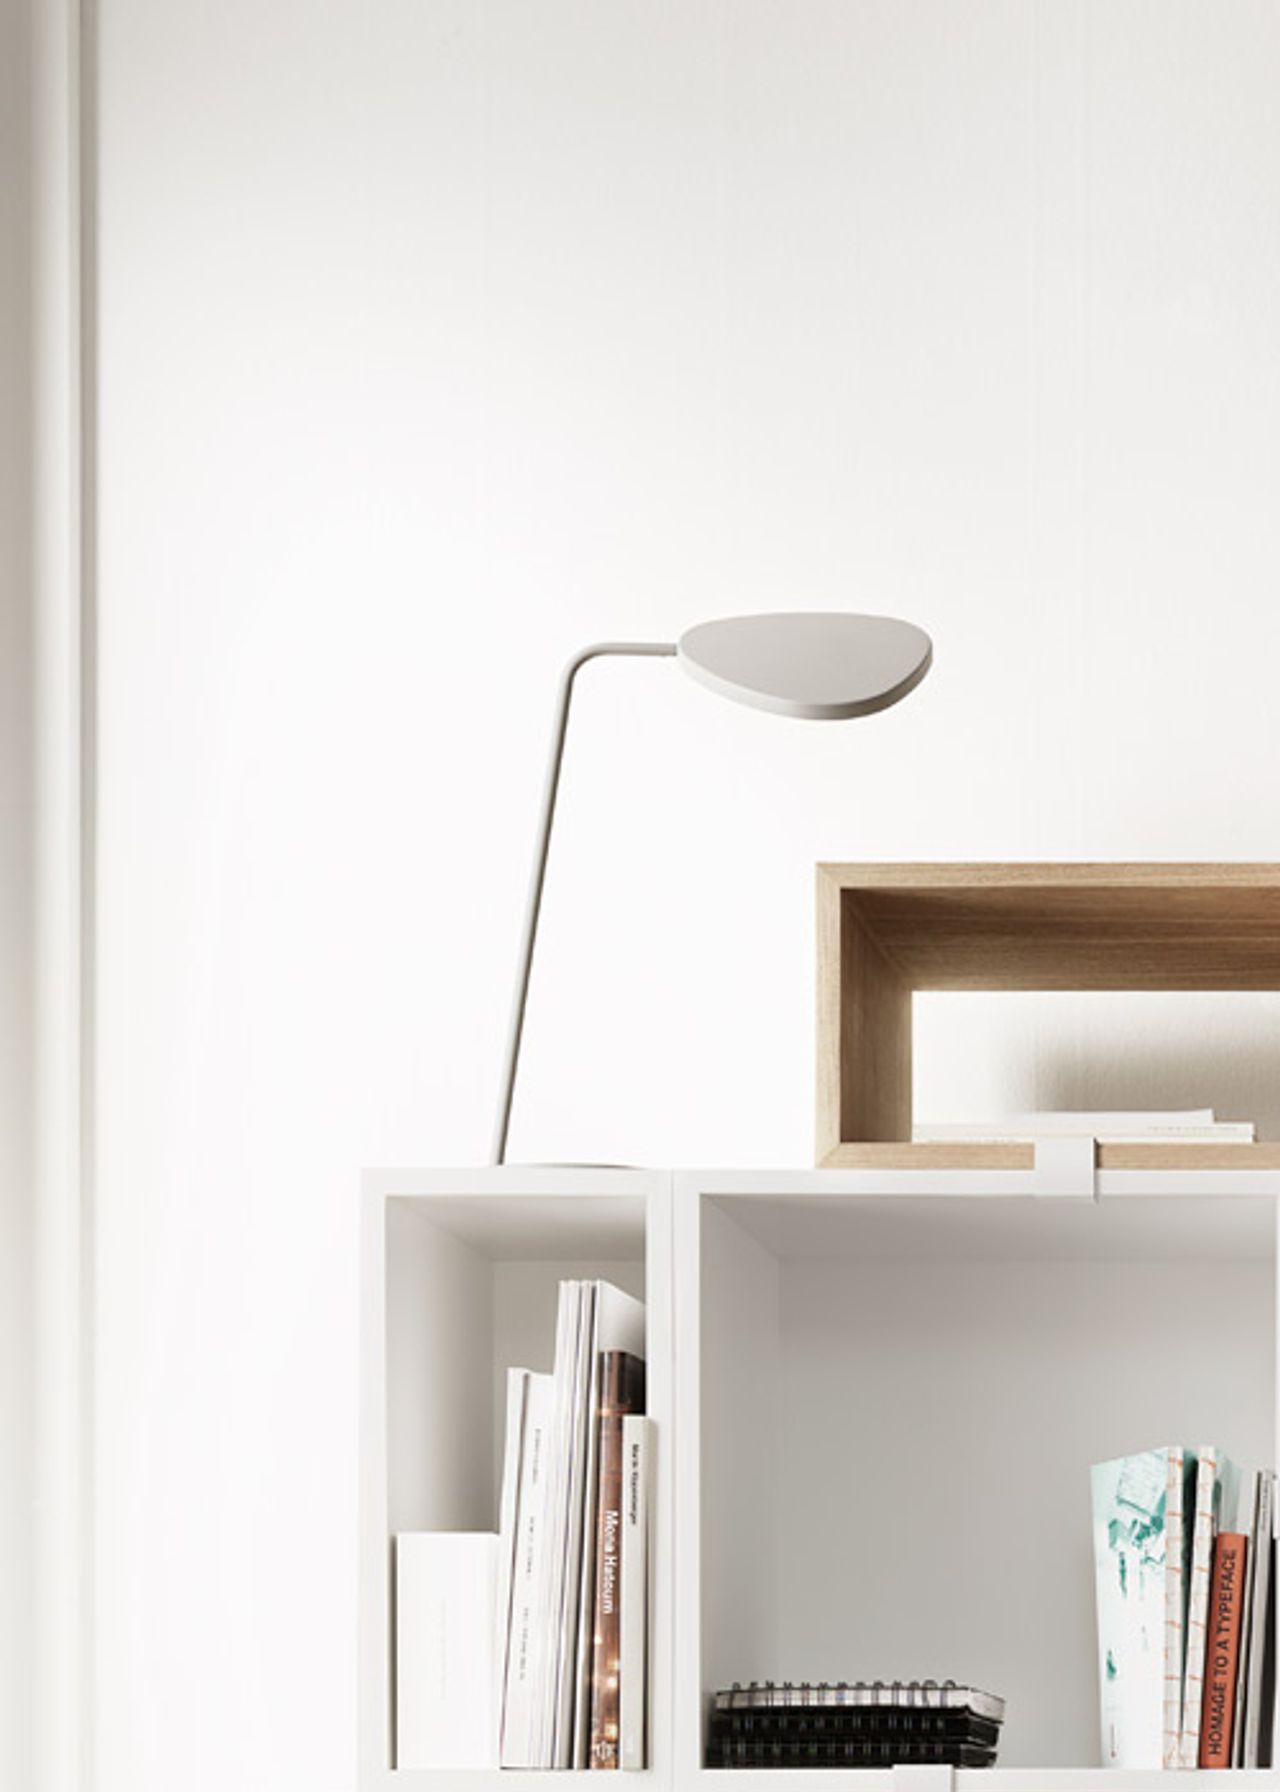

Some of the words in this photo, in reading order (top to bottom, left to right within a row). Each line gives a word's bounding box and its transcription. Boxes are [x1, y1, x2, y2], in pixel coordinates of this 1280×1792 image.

[603, 1510, 619, 1551] Mona
[1215, 1549, 1237, 1634] TYPEFACE
[1215, 1638, 1230, 1652] A
[1213, 1655, 1229, 1677] TO
[1207, 1681, 1227, 1756] HOMAGE
